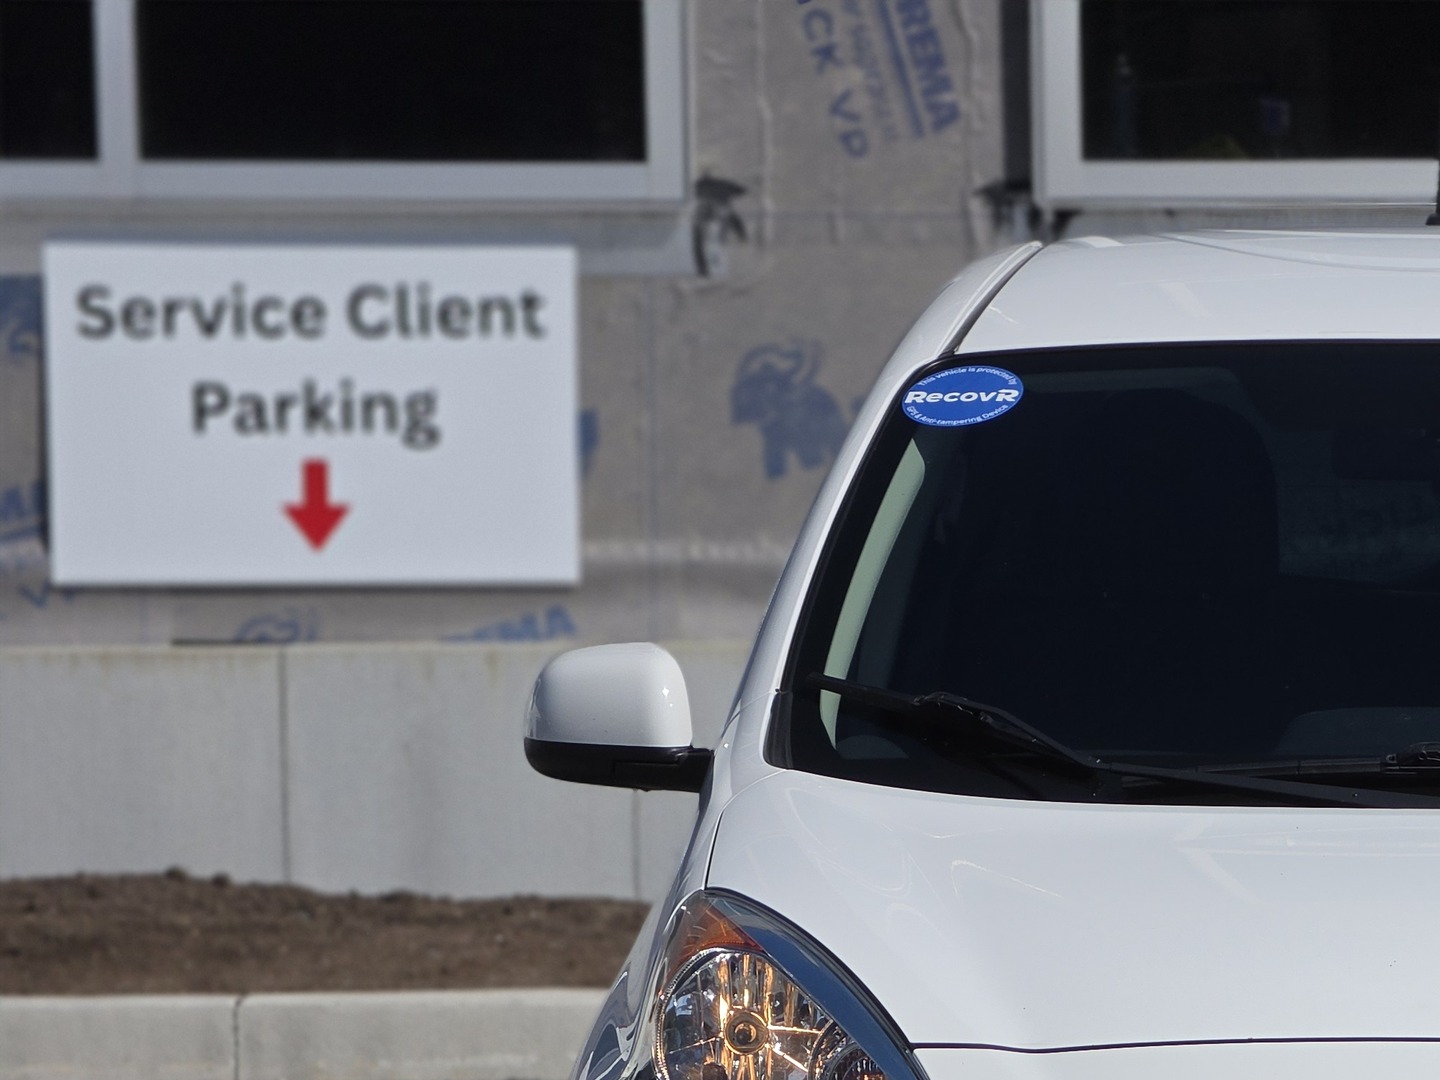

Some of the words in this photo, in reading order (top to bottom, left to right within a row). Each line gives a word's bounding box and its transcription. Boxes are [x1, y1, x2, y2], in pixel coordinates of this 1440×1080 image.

[75, 281, 327, 341] Service
[345, 281, 547, 341] Client
[935, 368, 967, 378] vehicle
[976, 367, 1013, 380] protected
[191, 376, 441, 451] Parking
[904, 388, 1020, 404] RecovR
